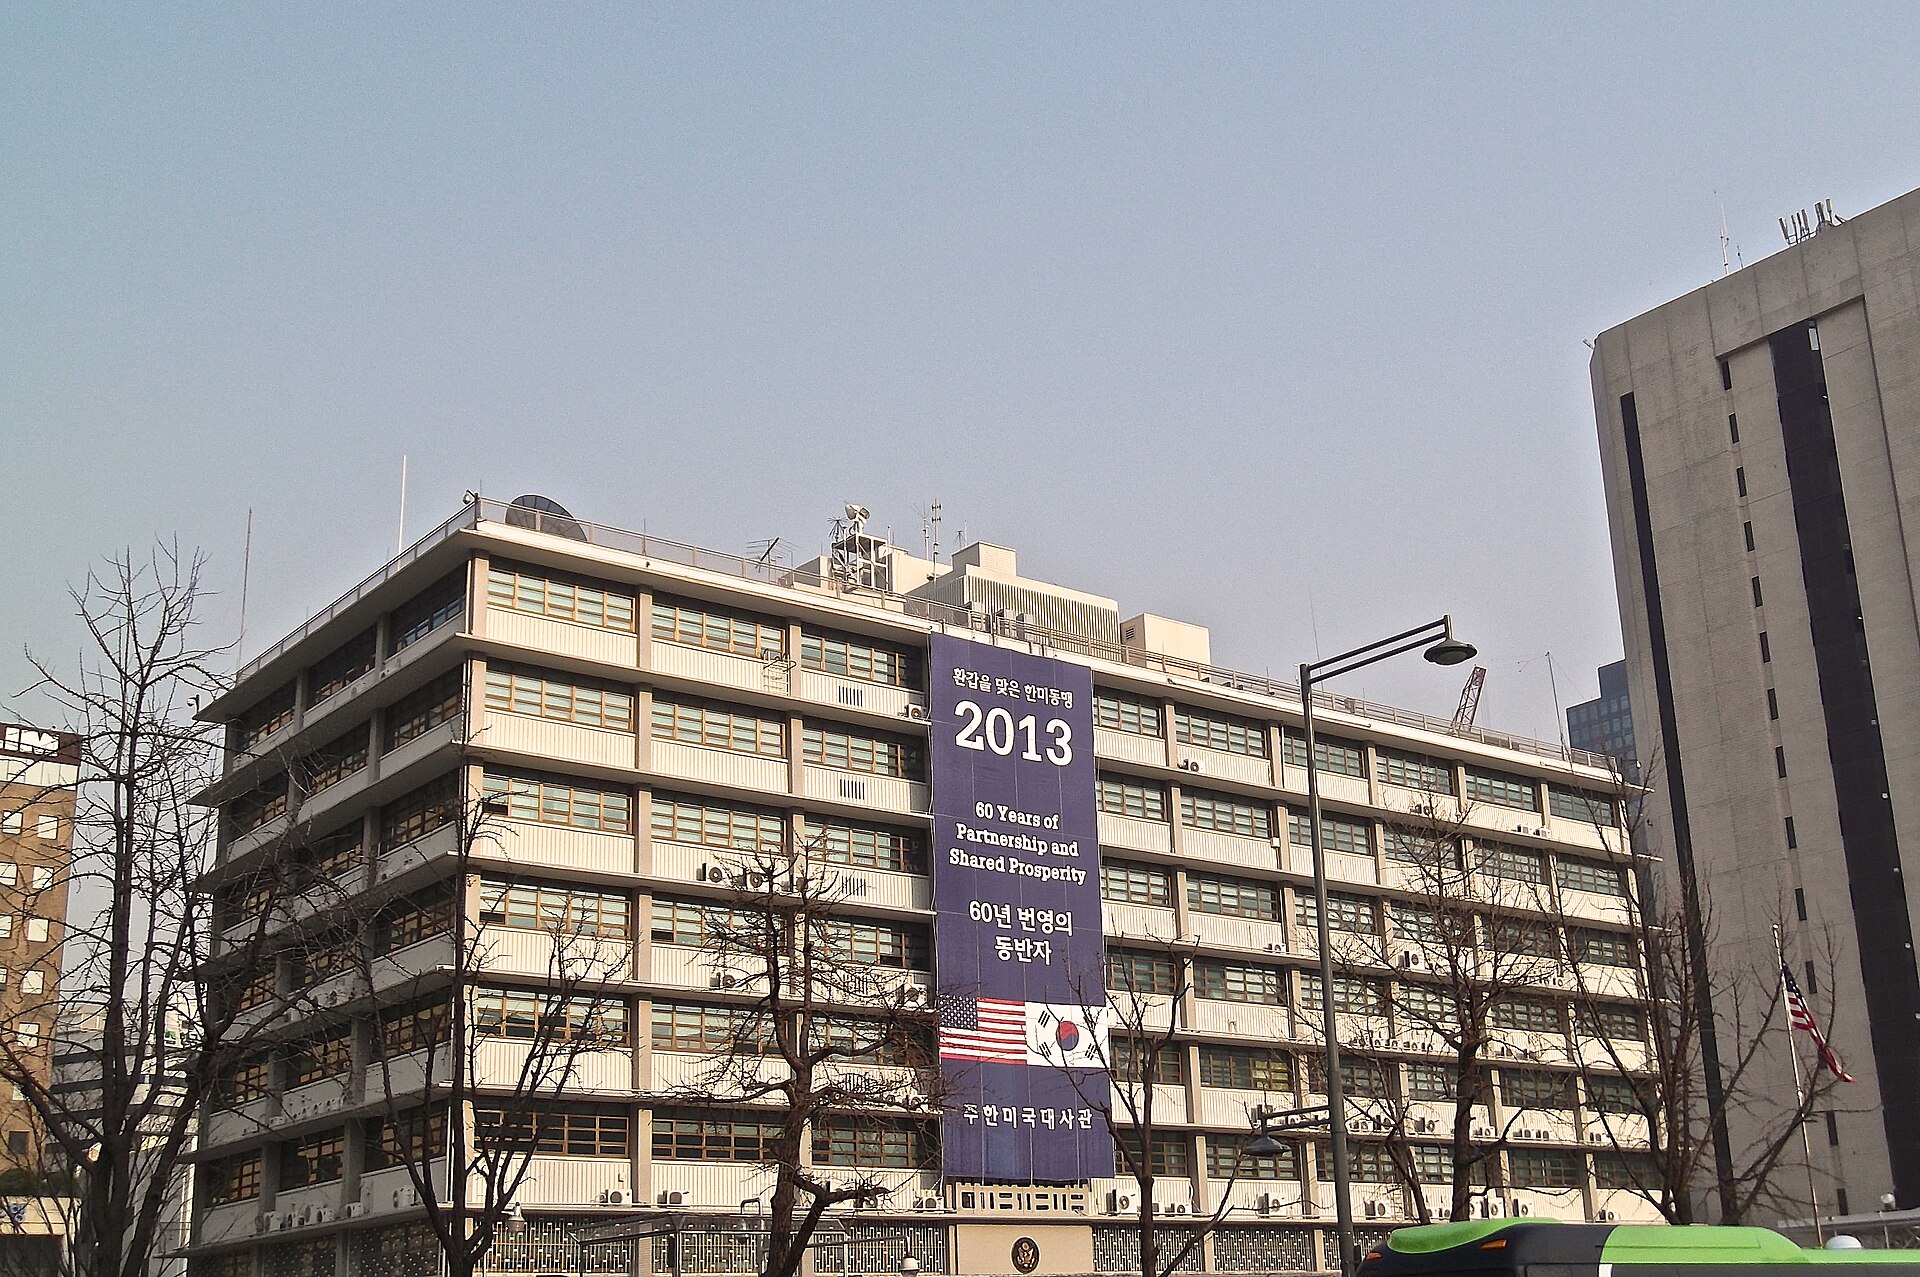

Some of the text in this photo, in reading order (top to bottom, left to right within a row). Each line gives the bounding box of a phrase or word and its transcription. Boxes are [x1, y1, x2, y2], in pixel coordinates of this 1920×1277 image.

[952, 667, 1073, 709] 환갑을 맞은 한미동맹
[954, 700, 1073, 766] 2013
[975, 801, 1059, 830] 60 Years of
[955, 822, 1079, 857] Partnership and
[949, 847, 1087, 886] Shared Prosperity
[969, 900, 1073, 937] 60년 번영의
[994, 935, 1053, 966] 동반자
[962, 1103, 1093, 1130] 주한미국대사관
